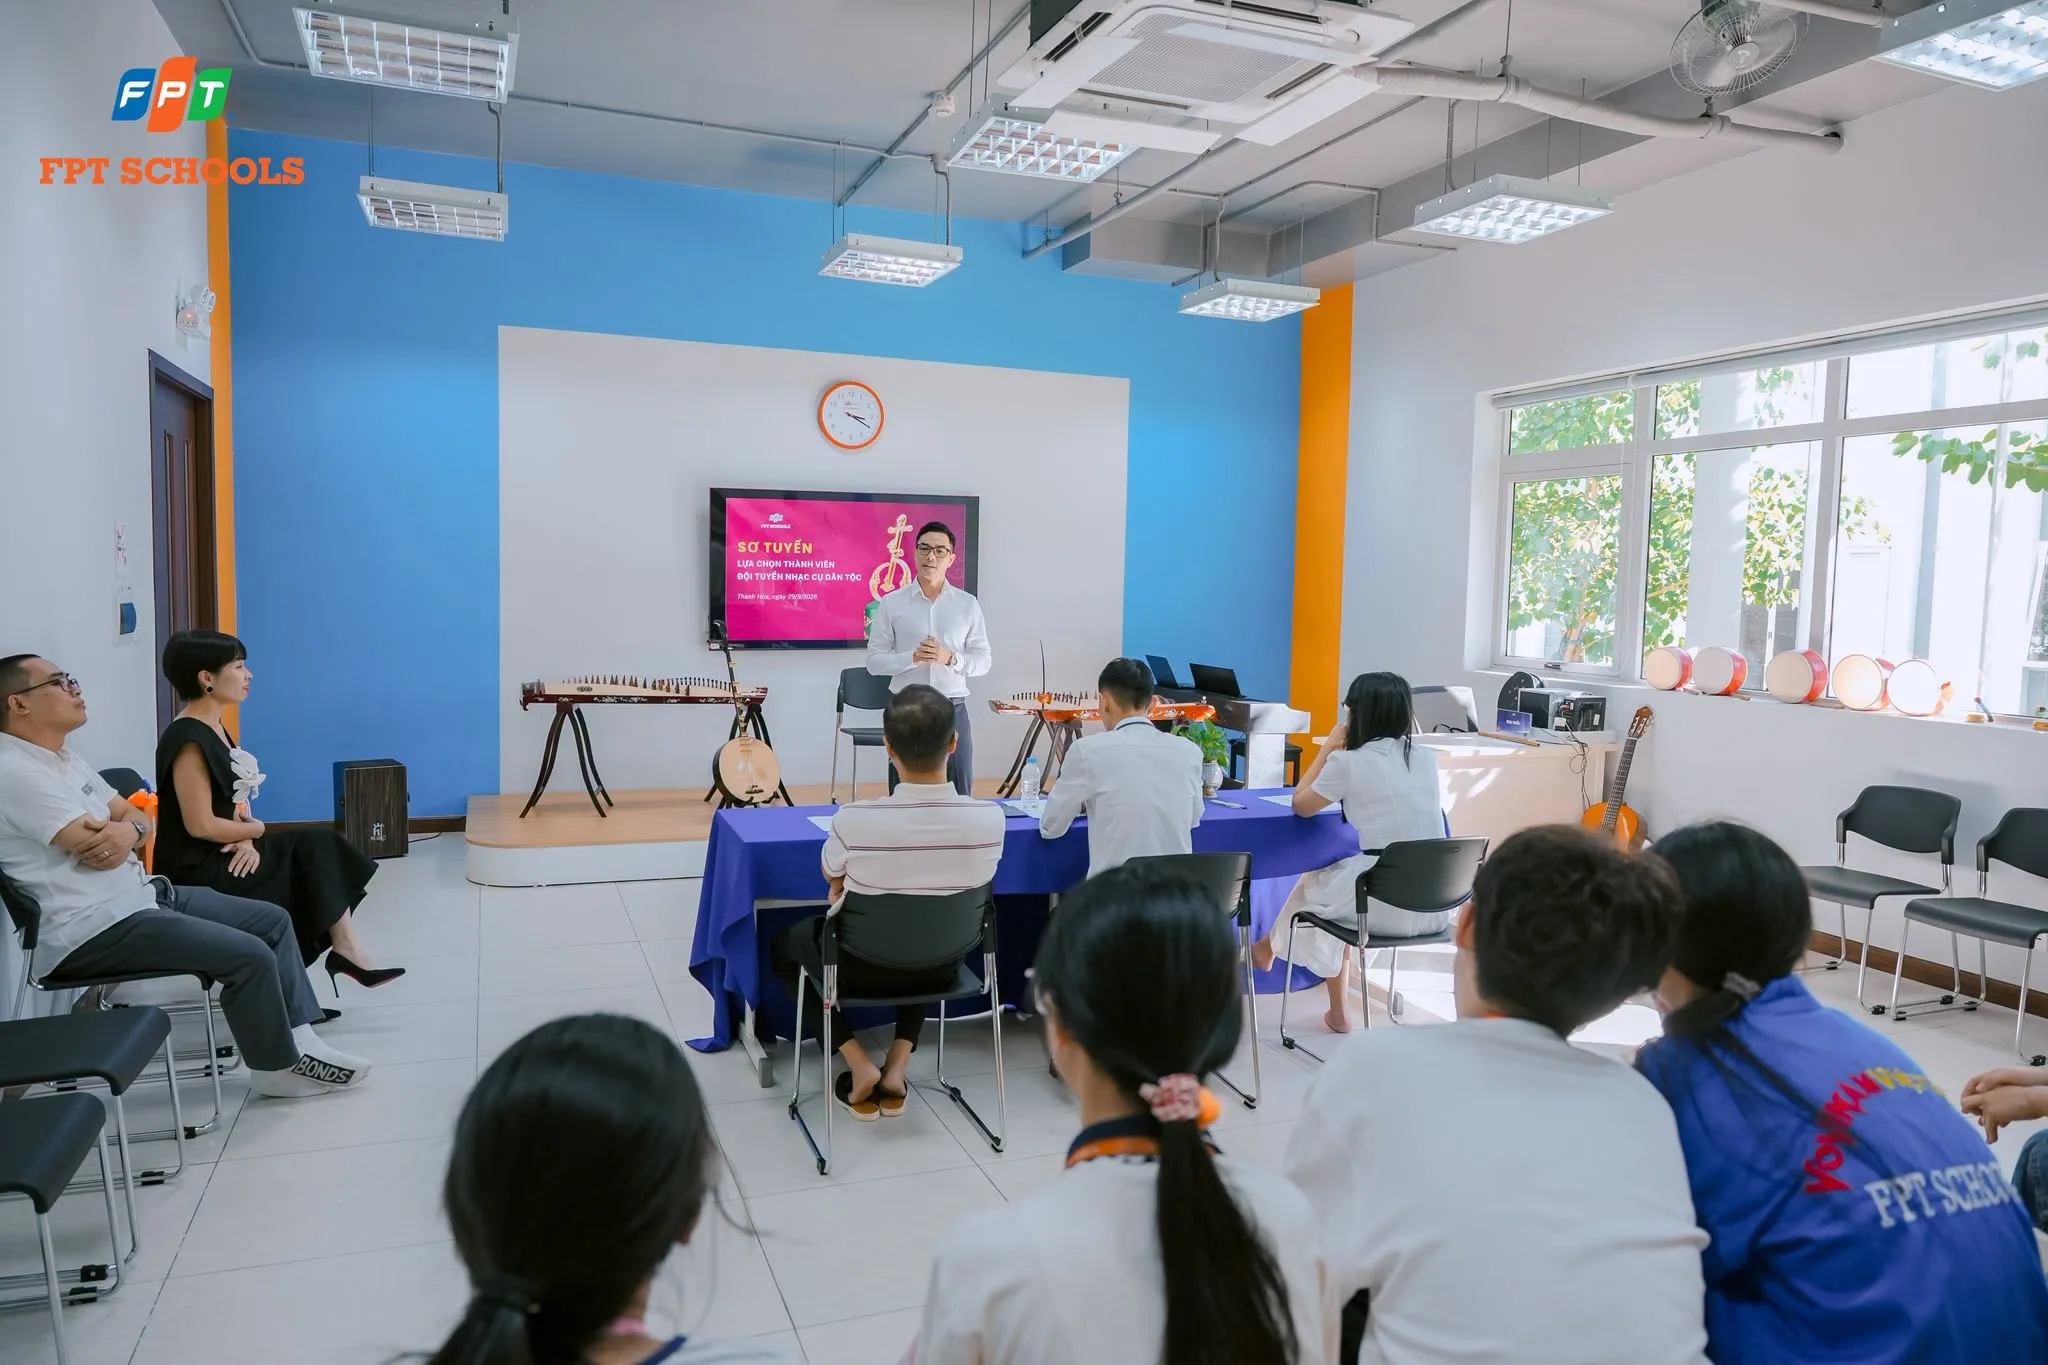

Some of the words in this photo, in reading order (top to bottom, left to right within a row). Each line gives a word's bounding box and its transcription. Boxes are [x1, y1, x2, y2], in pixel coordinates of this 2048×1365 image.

[737, 541, 760, 553] SƠ
[764, 538, 813, 554] TUYỂN
[737, 560, 754, 569] LỰA
[756, 560, 782, 569] CHỌN
[783, 560, 814, 568] THÀNH
[815, 560, 835, 569] VIÊN
[737, 572, 753, 582] ĐỘI
[785, 573, 810, 582] NHẠC
[811, 573, 824, 582] CỤ
[825, 572, 843, 581] DÂN
[844, 573, 862, 582] TỘC
[294, 1056, 350, 1082] BONDS
[1863, 1172, 1937, 1229] FPT
